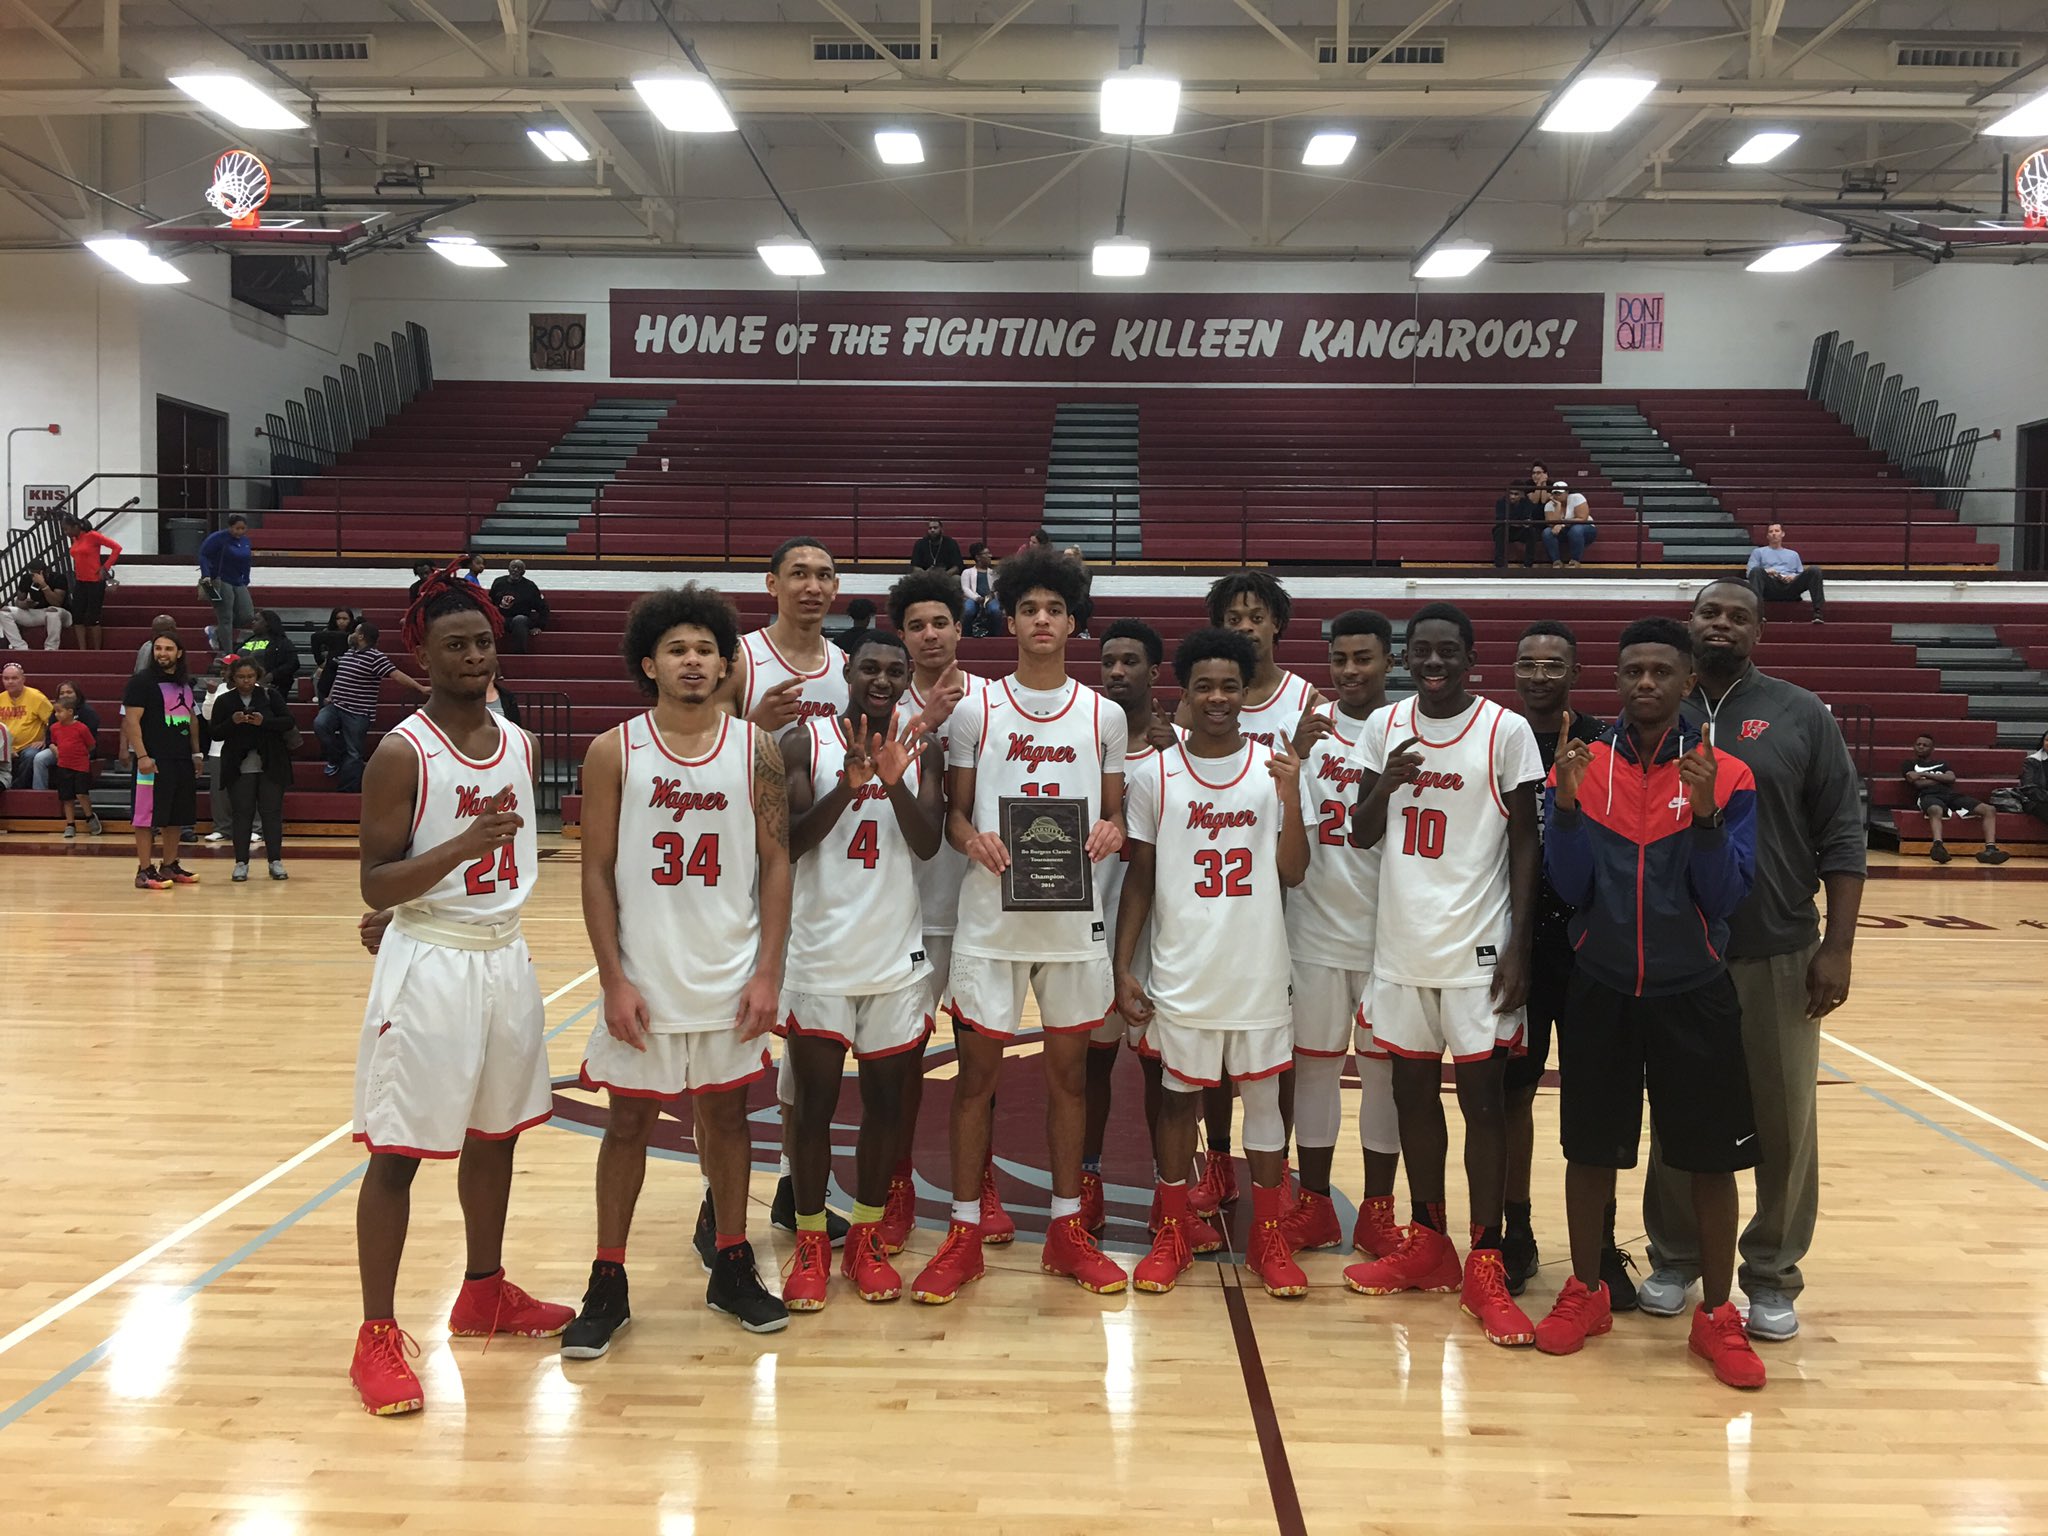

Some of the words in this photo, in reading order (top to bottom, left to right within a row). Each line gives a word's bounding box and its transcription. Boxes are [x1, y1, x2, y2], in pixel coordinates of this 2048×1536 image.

[1619, 297, 1663, 323] DONT
[533, 323, 585, 353] ROO
[635, 314, 767, 354] HOME
[776, 323, 818, 355] OF
[828, 323, 891, 356] THE
[903, 317, 1095, 357] FIGHTING
[1111, 318, 1283, 362] KILLEEN
[1299, 318, 1577, 362] KANGAROOS!
[1617, 322, 1662, 350] QUIT!
[30, 490, 65, 500] KHS
[1005, 732, 1077, 774] Wagner
[1317, 753, 1363, 793] Wagn
[648, 776, 729, 823] Wagner
[1407, 771, 1465, 798] gner
[1186, 800, 1258, 841] Wagner
[1319, 799, 1358, 849] 2
[1401, 805, 1448, 860] 10
[651, 831, 722, 887] 34
[847, 819, 880, 869] 4
[464, 840, 519, 896] 24
[1193, 847, 1253, 898] 32
